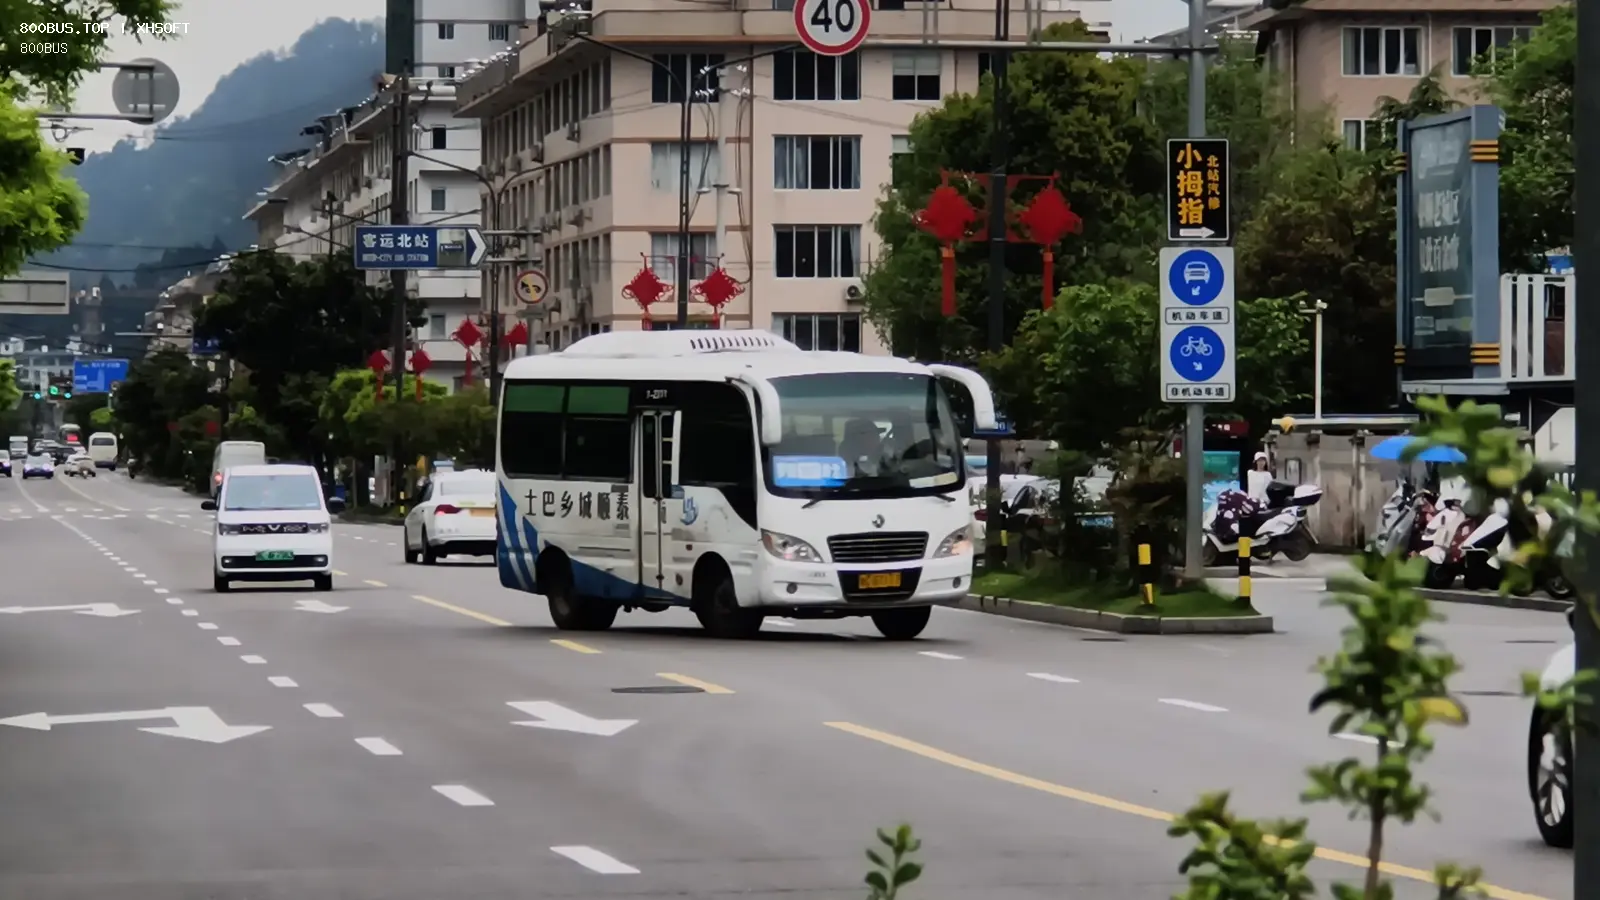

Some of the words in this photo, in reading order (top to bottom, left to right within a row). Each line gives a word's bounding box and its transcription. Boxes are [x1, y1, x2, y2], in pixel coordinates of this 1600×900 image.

[811, 0, 855, 33] 40
[1176, 142, 1204, 225] 小拇指
[362, 233, 429, 248] 客运北站
[1172, 311, 1223, 321] 机动车道
[1171, 387, 1225, 397] 非机动车道
